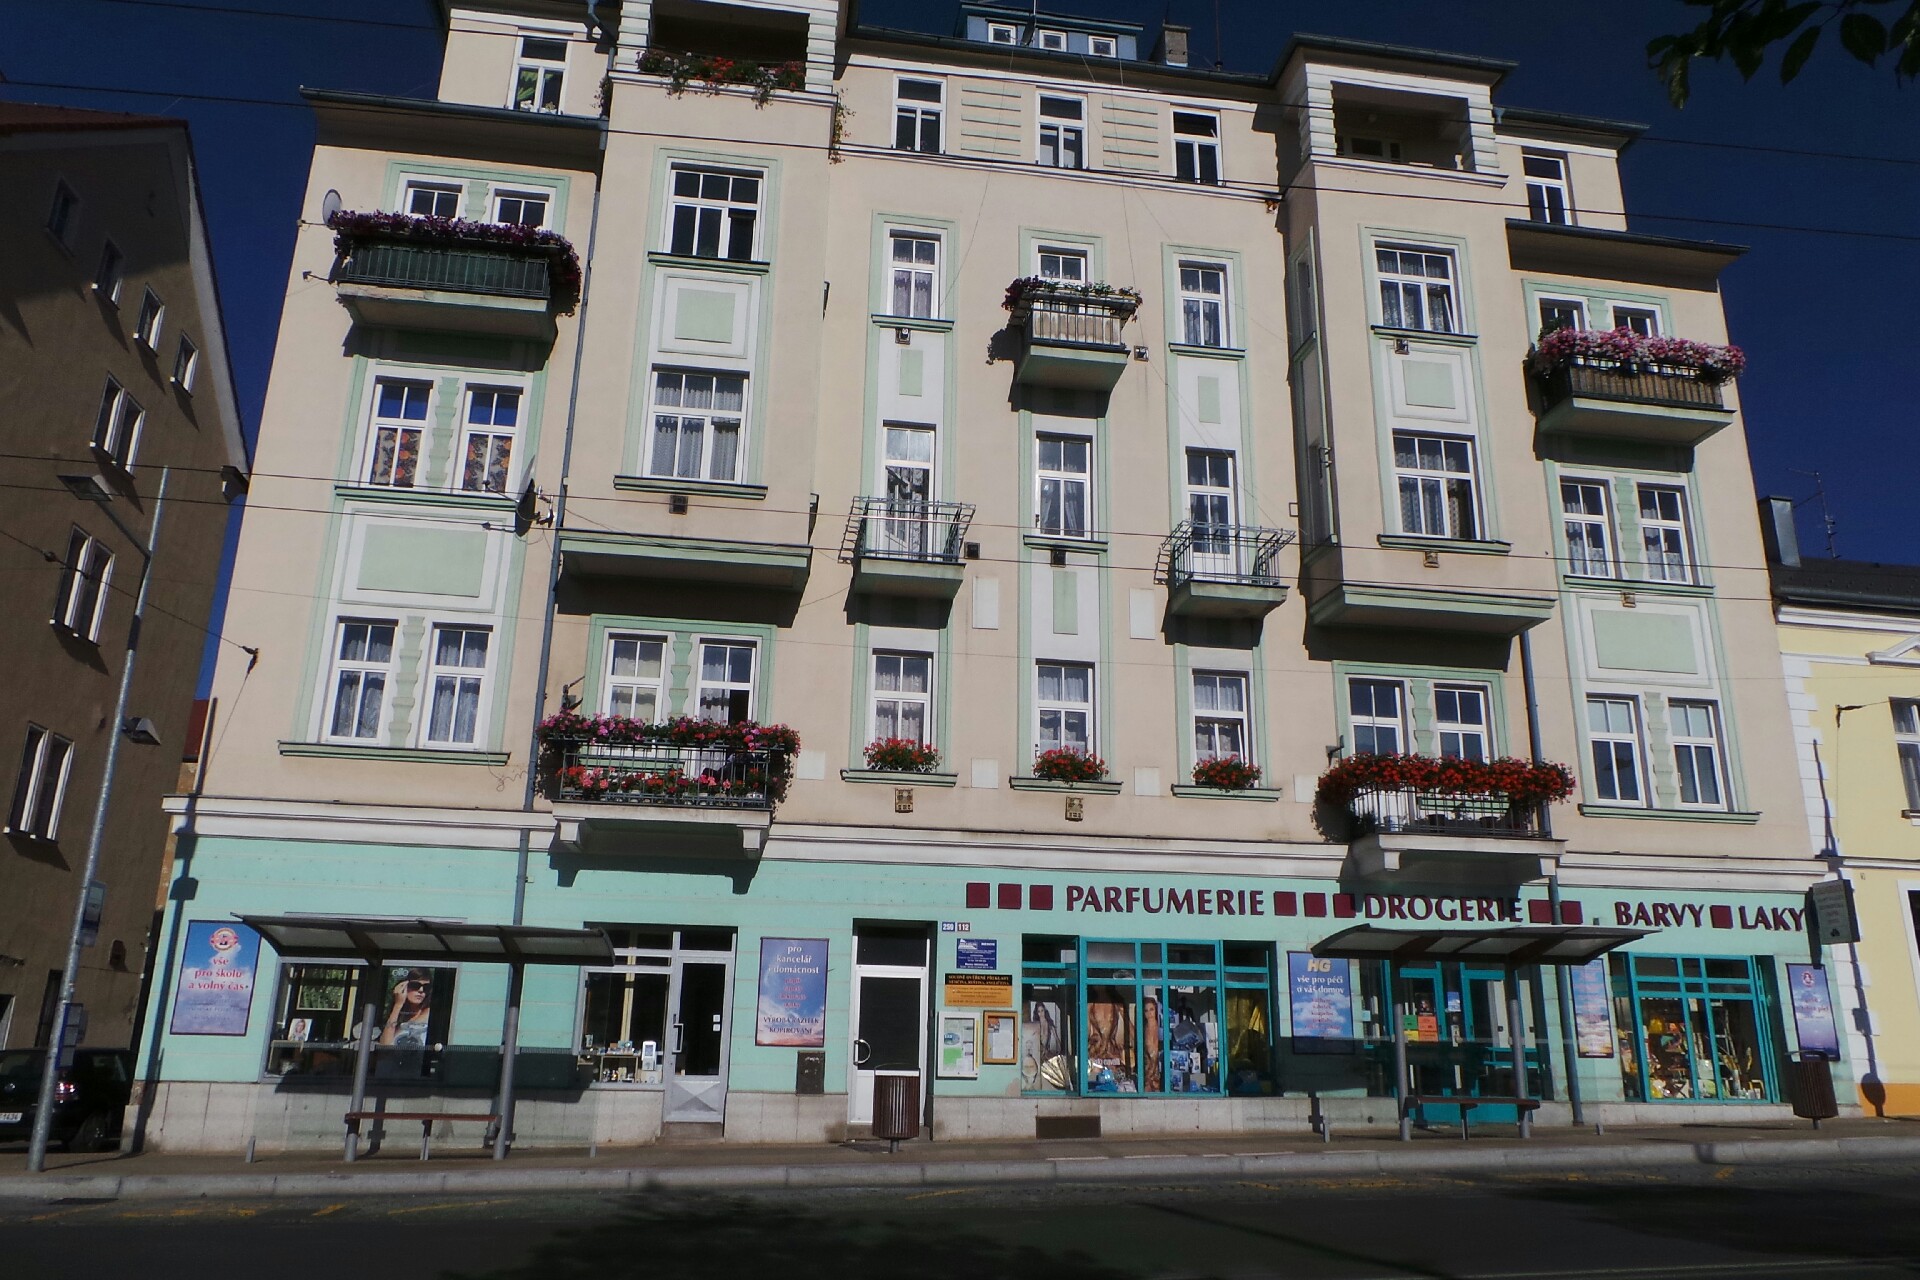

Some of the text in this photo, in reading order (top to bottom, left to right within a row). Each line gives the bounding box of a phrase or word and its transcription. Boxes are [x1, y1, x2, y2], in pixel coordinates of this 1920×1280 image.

[1066, 885, 1263, 916] PARFUMERIE
[1364, 894, 1523, 923] DROGERIE
[1614, 901, 1705, 928] BARVY
[1738, 905, 1805, 932] LAKY
[958, 923, 970, 931] 112
[788, 946, 802, 955] pro
[213, 957, 229, 965] vše
[776, 954, 812, 963] kancelář
[774, 965, 819, 974] domácnost
[1308, 959, 1331, 973] HG
[195, 969, 243, 979] pro školu
[1297, 975, 1343, 986] vše pro péči
[198, 981, 225, 990] volný
[228, 981, 244, 991] čas
[1304, 985, 1315, 994] váš
[1318, 985, 1344, 994] domov
